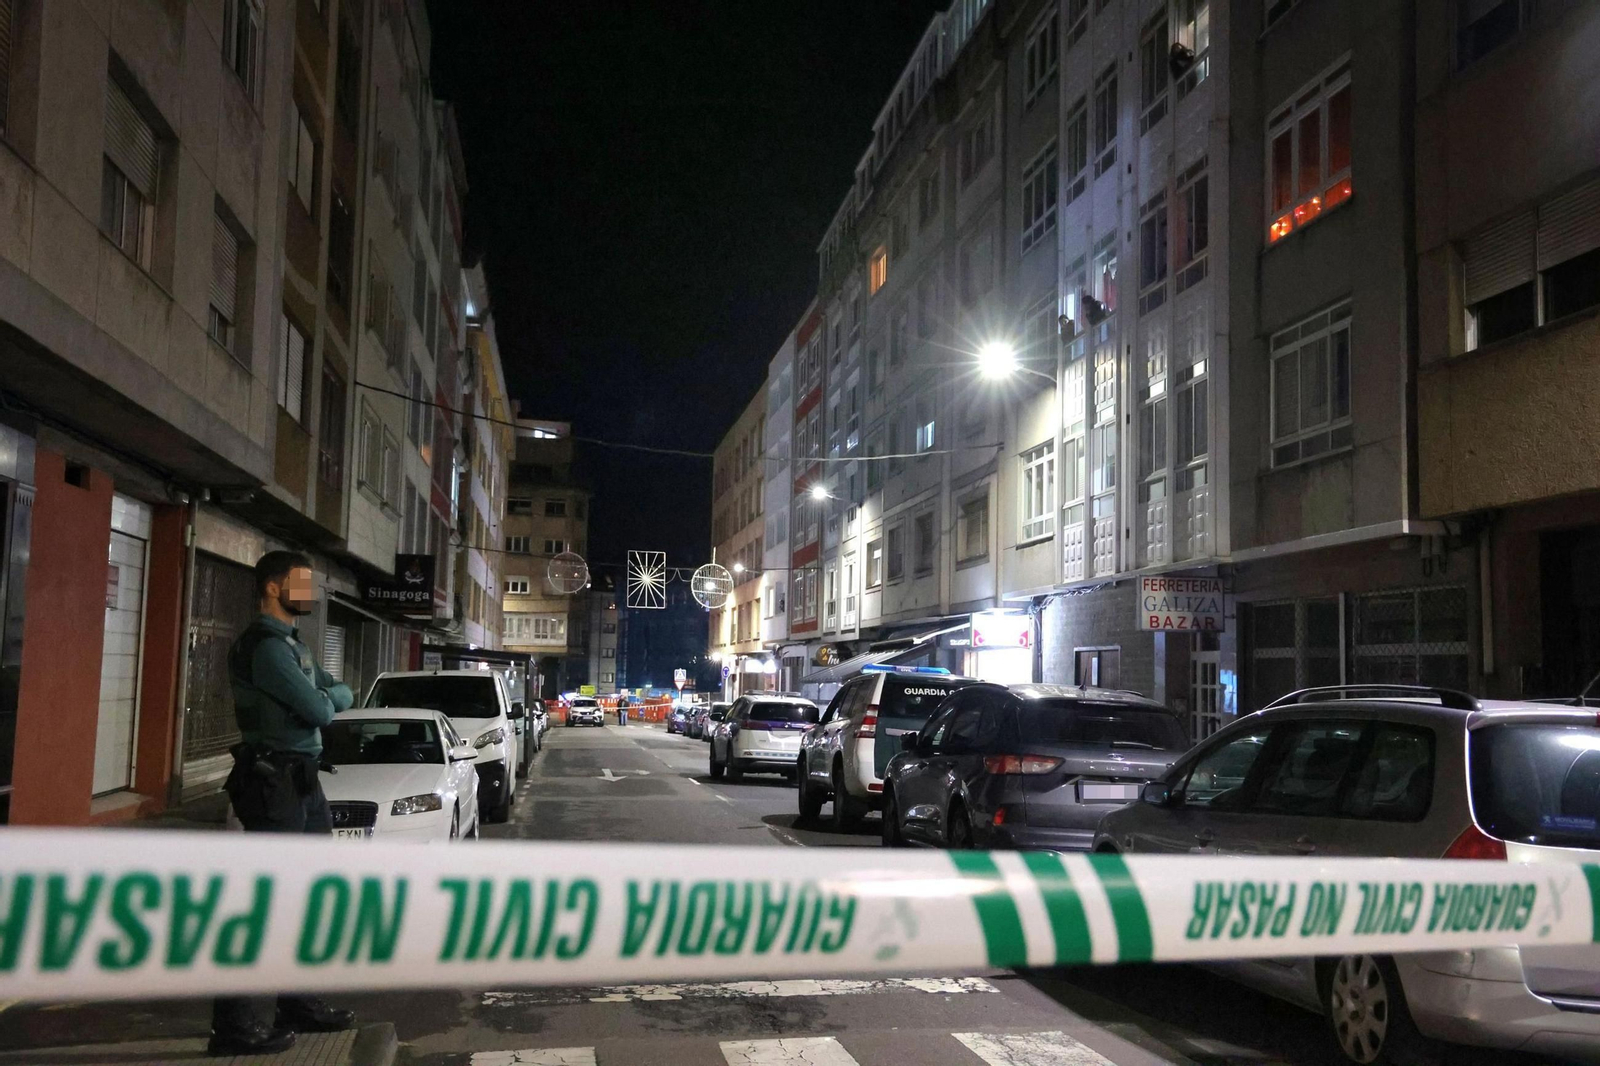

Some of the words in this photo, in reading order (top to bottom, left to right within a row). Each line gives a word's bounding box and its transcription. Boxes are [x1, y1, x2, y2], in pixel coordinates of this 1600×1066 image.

[368, 586, 430, 602] Sinagoga
[1143, 578, 1221, 593] FERRETERIA
[1144, 595, 1220, 613] GALIZA
[1149, 615, 1216, 629] BAZAR
[904, 687, 947, 697] GUARDIA
[295, 874, 409, 966] NO
[437, 877, 600, 963] CIVIL
[619, 878, 858, 958] GUARDIA
[1185, 880, 1297, 939] PASAR
[1299, 881, 1348, 938] NO
[1353, 882, 1424, 936] CIVIL
[1425, 882, 1537, 934] GUARDIA
